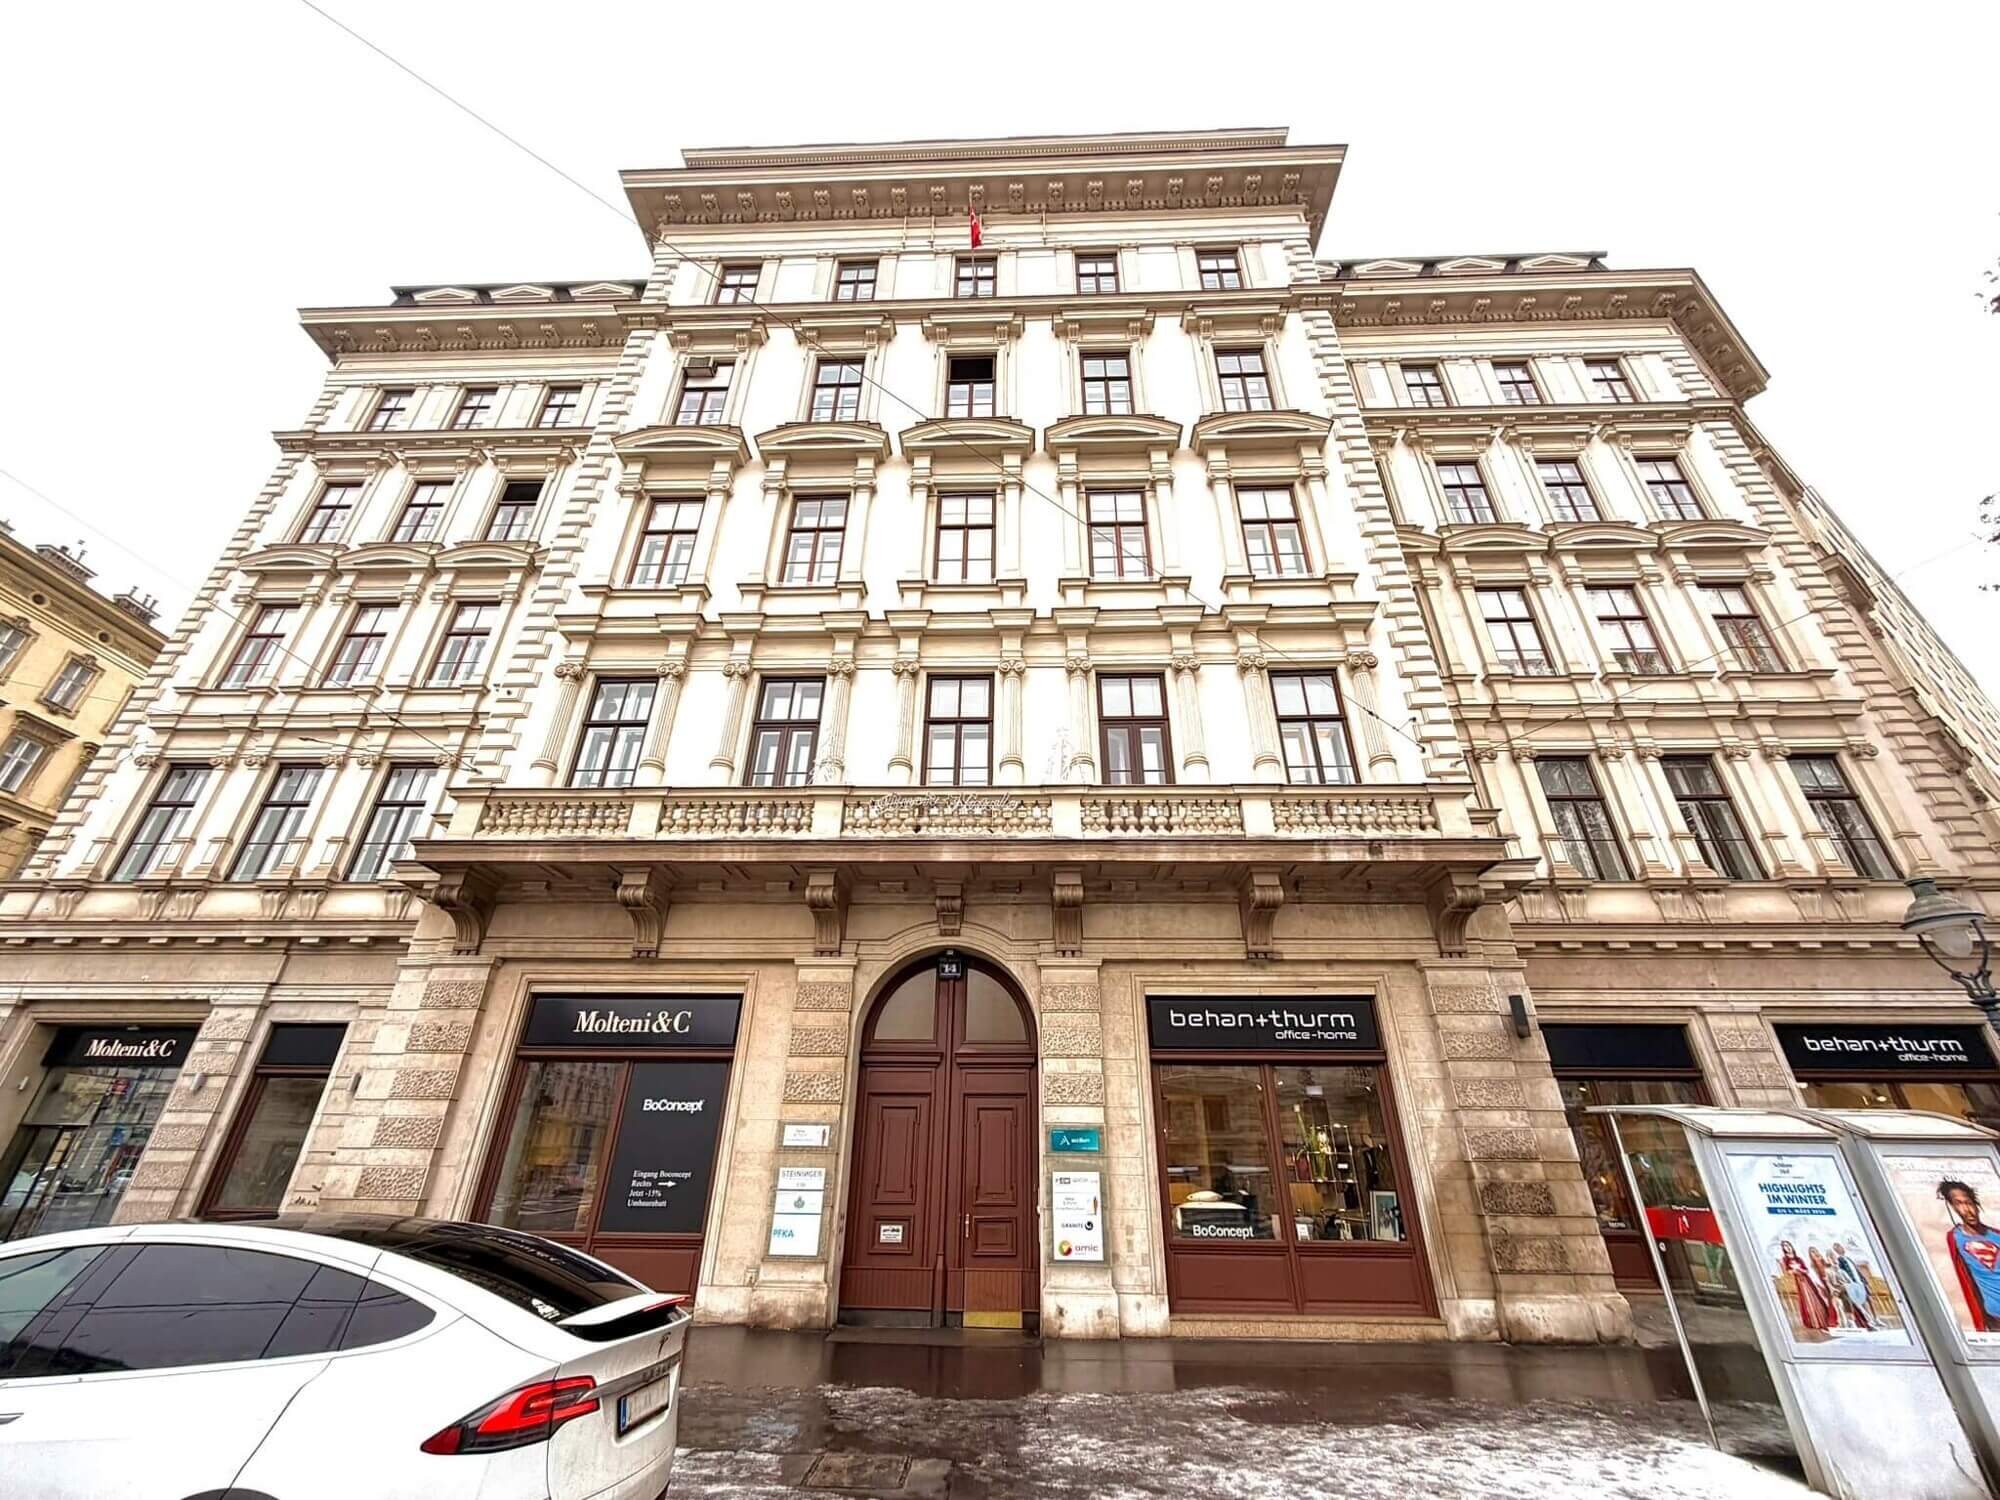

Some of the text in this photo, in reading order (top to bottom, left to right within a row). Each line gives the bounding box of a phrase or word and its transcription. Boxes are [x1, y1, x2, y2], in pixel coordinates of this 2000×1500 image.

[573, 1010, 692, 1033] Molteni&C
[1170, 1009, 1355, 1027] behan+thurm
[1275, 1030, 1357, 1040] office-home
[84, 1039, 176, 1057] Molteni&C
[1803, 1036, 1963, 1051] behan+thurm
[1898, 1053, 1968, 1062] office-home
[643, 1099, 704, 1114] BoConcept
[633, 1170, 658, 1179] Eingang
[1758, 1183, 1826, 1194] HIGHLIGHTS
[1767, 1194, 1828, 1205] IM WINTER
[1193, 1225, 1254, 1239] BoConcept
